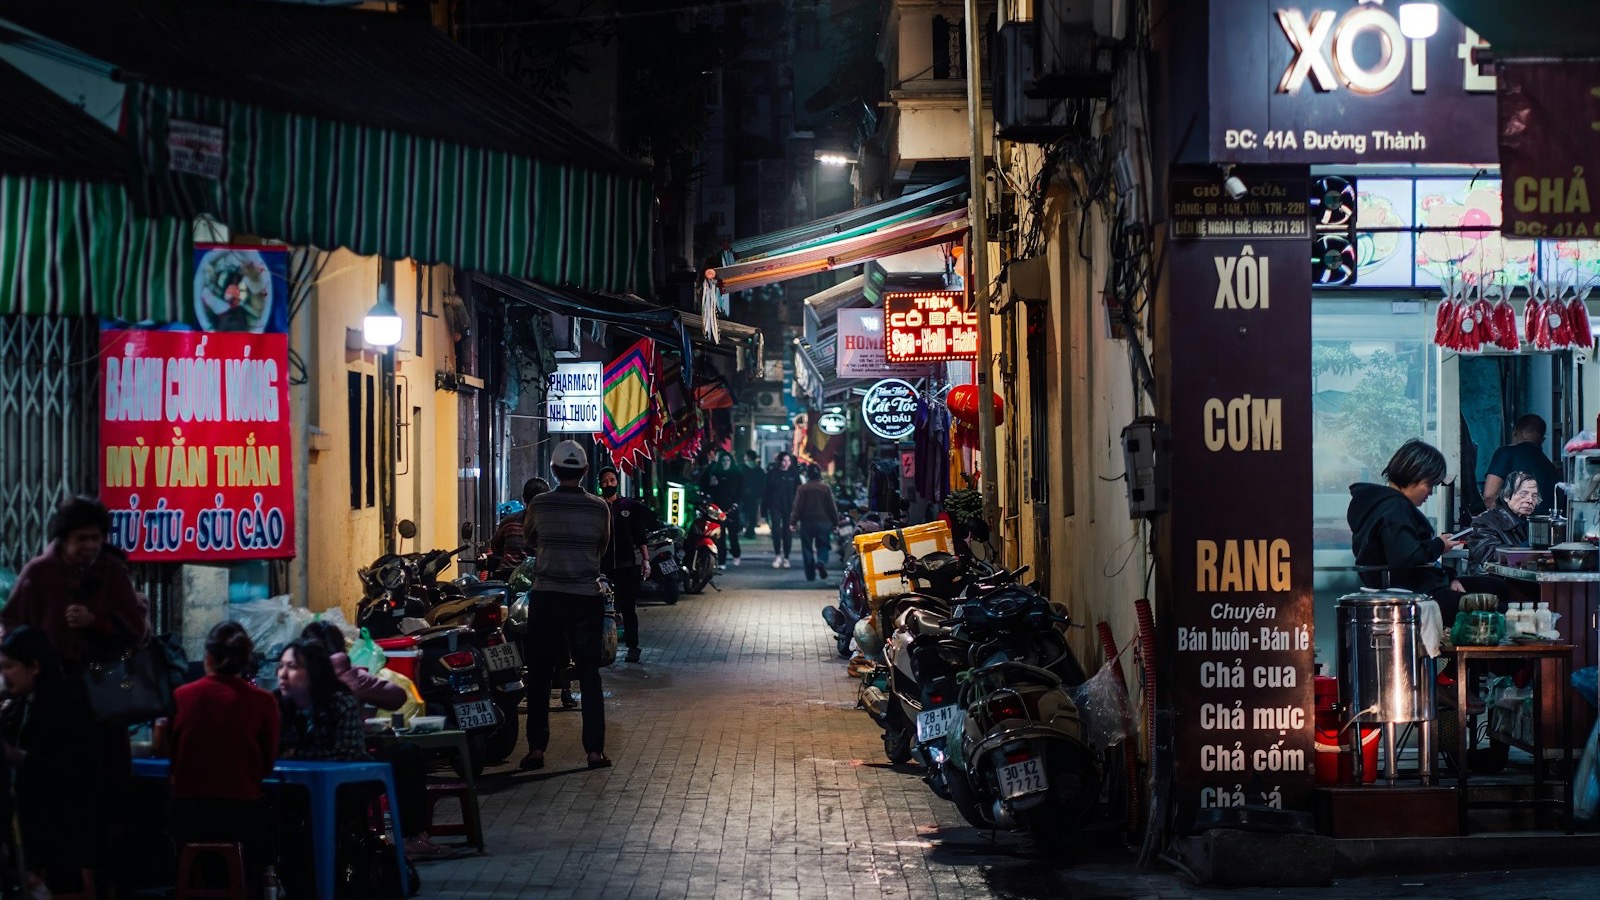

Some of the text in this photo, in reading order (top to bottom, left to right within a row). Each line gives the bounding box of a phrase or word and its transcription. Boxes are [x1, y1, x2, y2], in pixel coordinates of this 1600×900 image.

[1225, 130, 1426, 154] ĐC: 41A Đường Thành
[1513, 165, 1591, 214] CHẢ
[1274, 221, 1288, 234] 371
[1552, 221, 1589, 236] 41A
[1214, 245, 1269, 309] XÔI
[890, 309, 922, 327] CÔ
[914, 296, 953, 311] TIỆM
[891, 330, 916, 358] Spa
[921, 327, 946, 353] Nail
[105, 335, 279, 422] BÁNH CUỐN NÓNG
[550, 373, 598, 391] PHARMACY
[549, 398, 597, 422] NHÀ THUỐC
[874, 413, 891, 424] GỘI
[1203, 394, 1282, 451] CƠM
[106, 426, 281, 488] MỲ VẰN THẮN
[143, 497, 184, 551] TÍU
[196, 492, 235, 551] SỦI
[236, 491, 284, 550] CẢO
[1197, 538, 1292, 592] RANG
[1210, 603, 1276, 623] Chuyên
[1178, 626, 1207, 651] Bán
[1294, 624, 1309, 651] lẻ
[1200, 658, 1297, 689] Chả cua
[1200, 700, 1305, 736] Chả mực
[1200, 740, 1305, 772] Chả cốm
[1200, 784, 1245, 809] Chả
